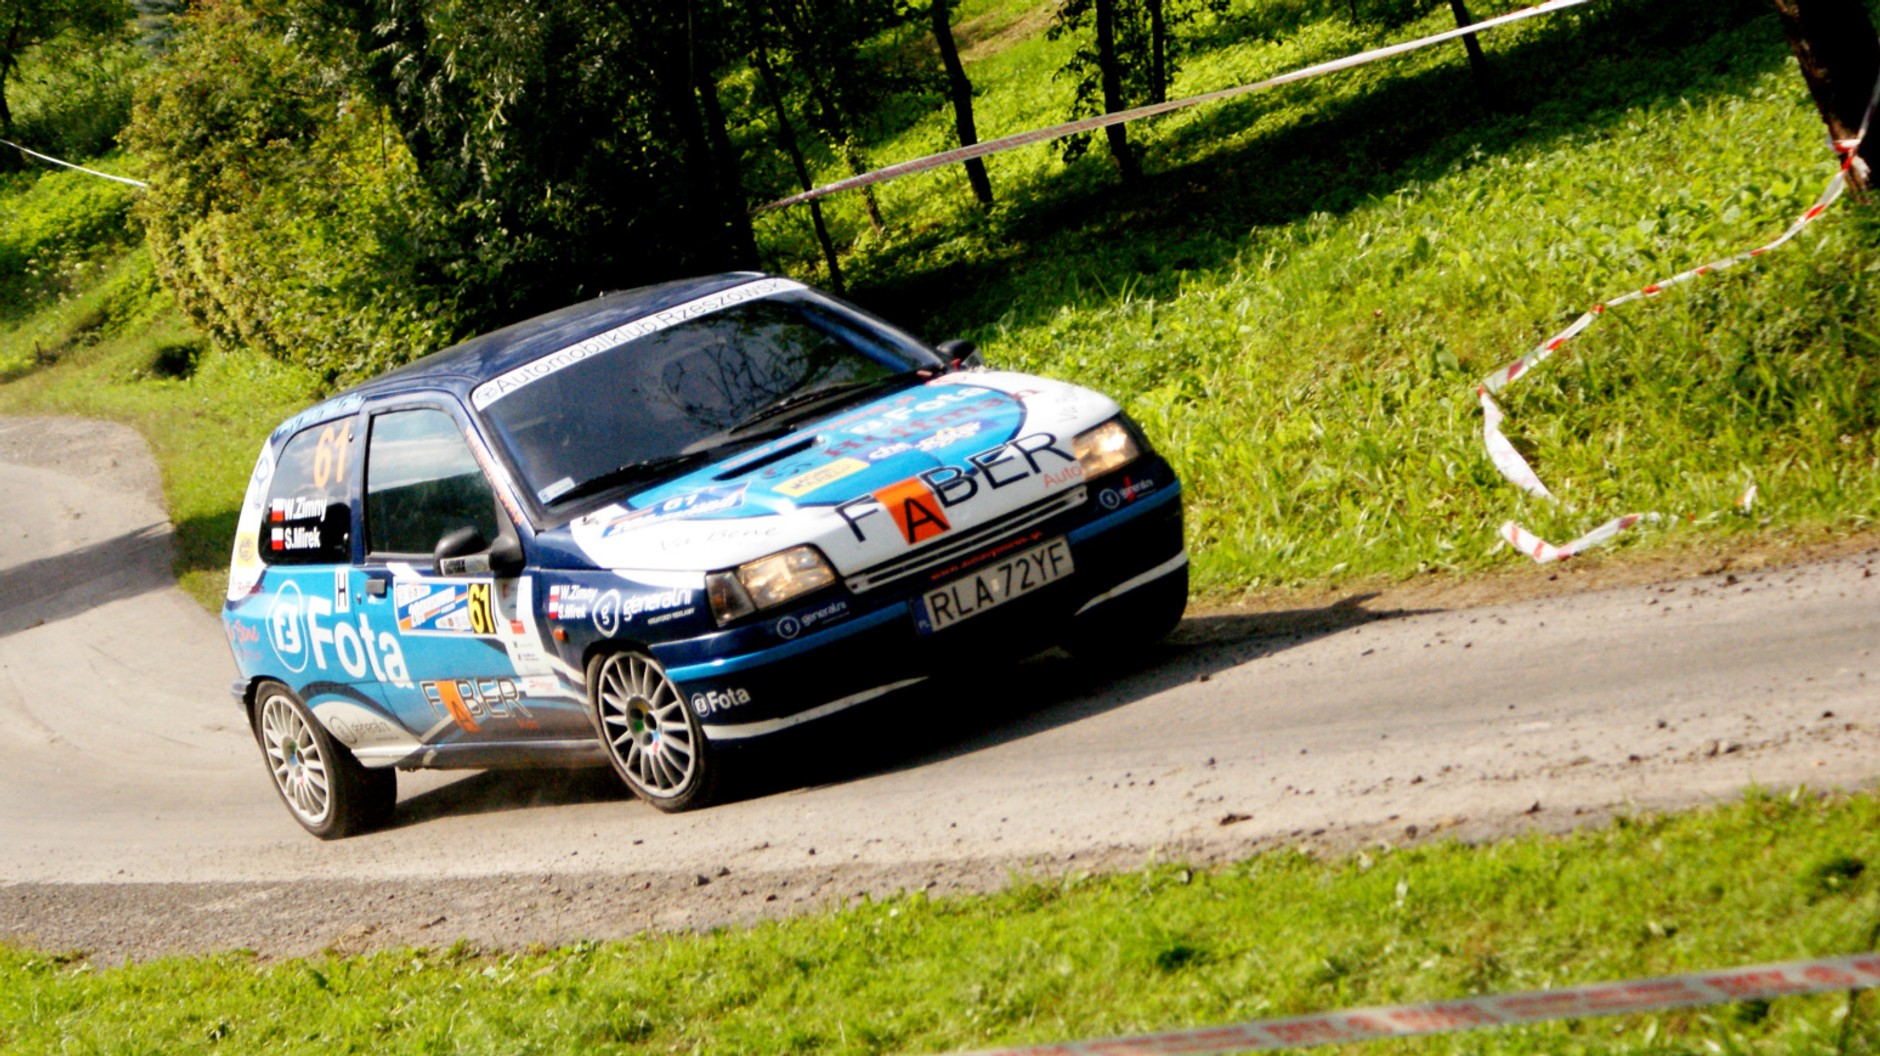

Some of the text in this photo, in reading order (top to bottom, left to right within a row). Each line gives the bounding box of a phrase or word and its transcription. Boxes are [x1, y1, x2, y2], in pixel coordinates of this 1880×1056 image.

[496, 315, 658, 394] Automobilklub
[883, 387, 992, 421] Fota
[313, 421, 350, 488] 61
[835, 432, 1076, 544] FABER
[1043, 465, 1083, 489] Auto
[284, 496, 327, 522] W.Zimny
[284, 526, 321, 549] S.Mirek
[337, 572, 348, 607] H
[560, 584, 599, 603] W.Zimny
[930, 580, 995, 626] RLA
[999, 543, 1066, 598] 72YF
[468, 583, 495, 634] 61
[558, 602, 587, 619] S.Mirek
[306, 596, 414, 689] Fota
[419, 678, 533, 732] FABER
[706, 687, 751, 713] Fota
